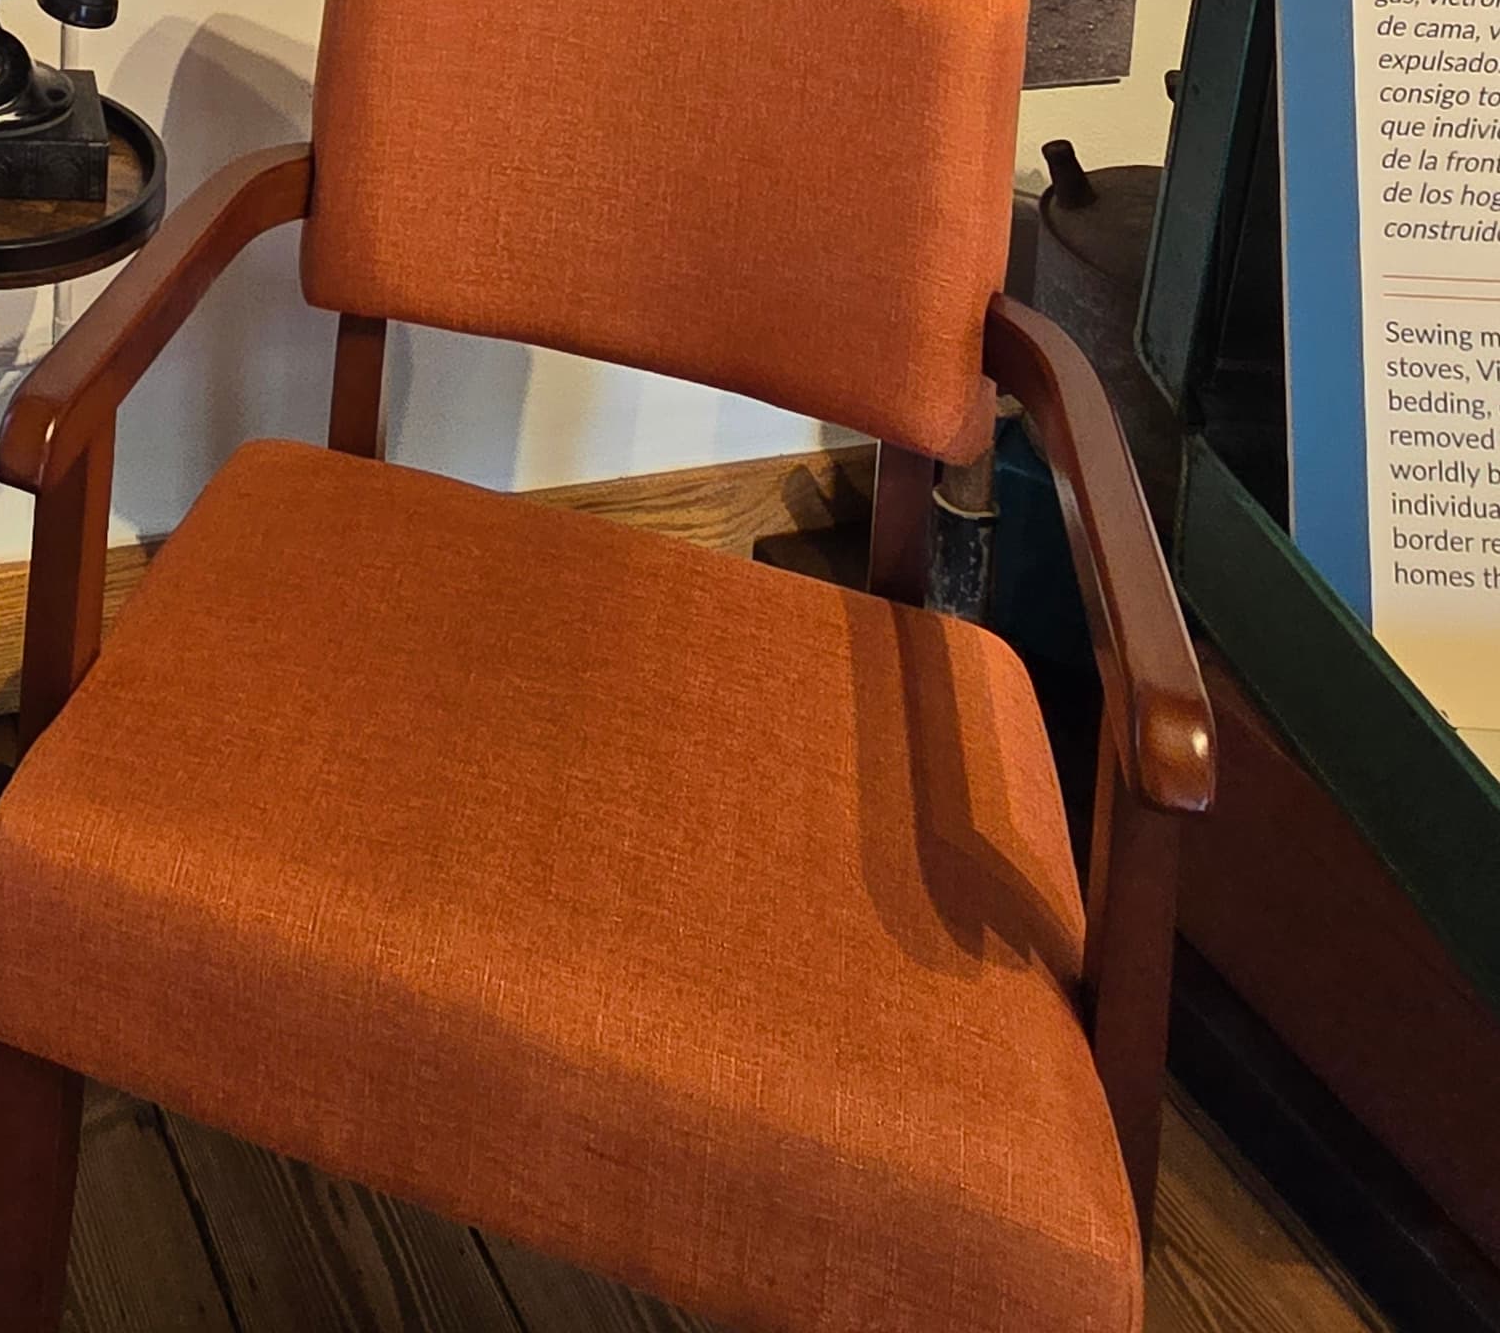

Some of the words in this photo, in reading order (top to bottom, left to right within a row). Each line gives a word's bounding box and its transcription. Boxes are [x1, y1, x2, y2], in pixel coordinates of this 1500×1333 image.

[1377, 14, 1407, 37] de
[1413, 22, 1481, 43] cama,
[1379, 83, 1471, 110] consigo
[1380, 119, 1426, 141] que
[1381, 147, 1412, 170] de
[1418, 148, 1438, 171] la
[1382, 180, 1413, 203] de
[1419, 182, 1454, 205] los
[1386, 321, 1473, 352] Sewing
[1386, 356, 1470, 383] stoves,
[1388, 388, 1492, 420] bedding,
[1390, 427, 1495, 450] removed
[1390, 459, 1481, 488] worldly
[1393, 526, 1474, 553] border
[1394, 561, 1475, 588] homes
